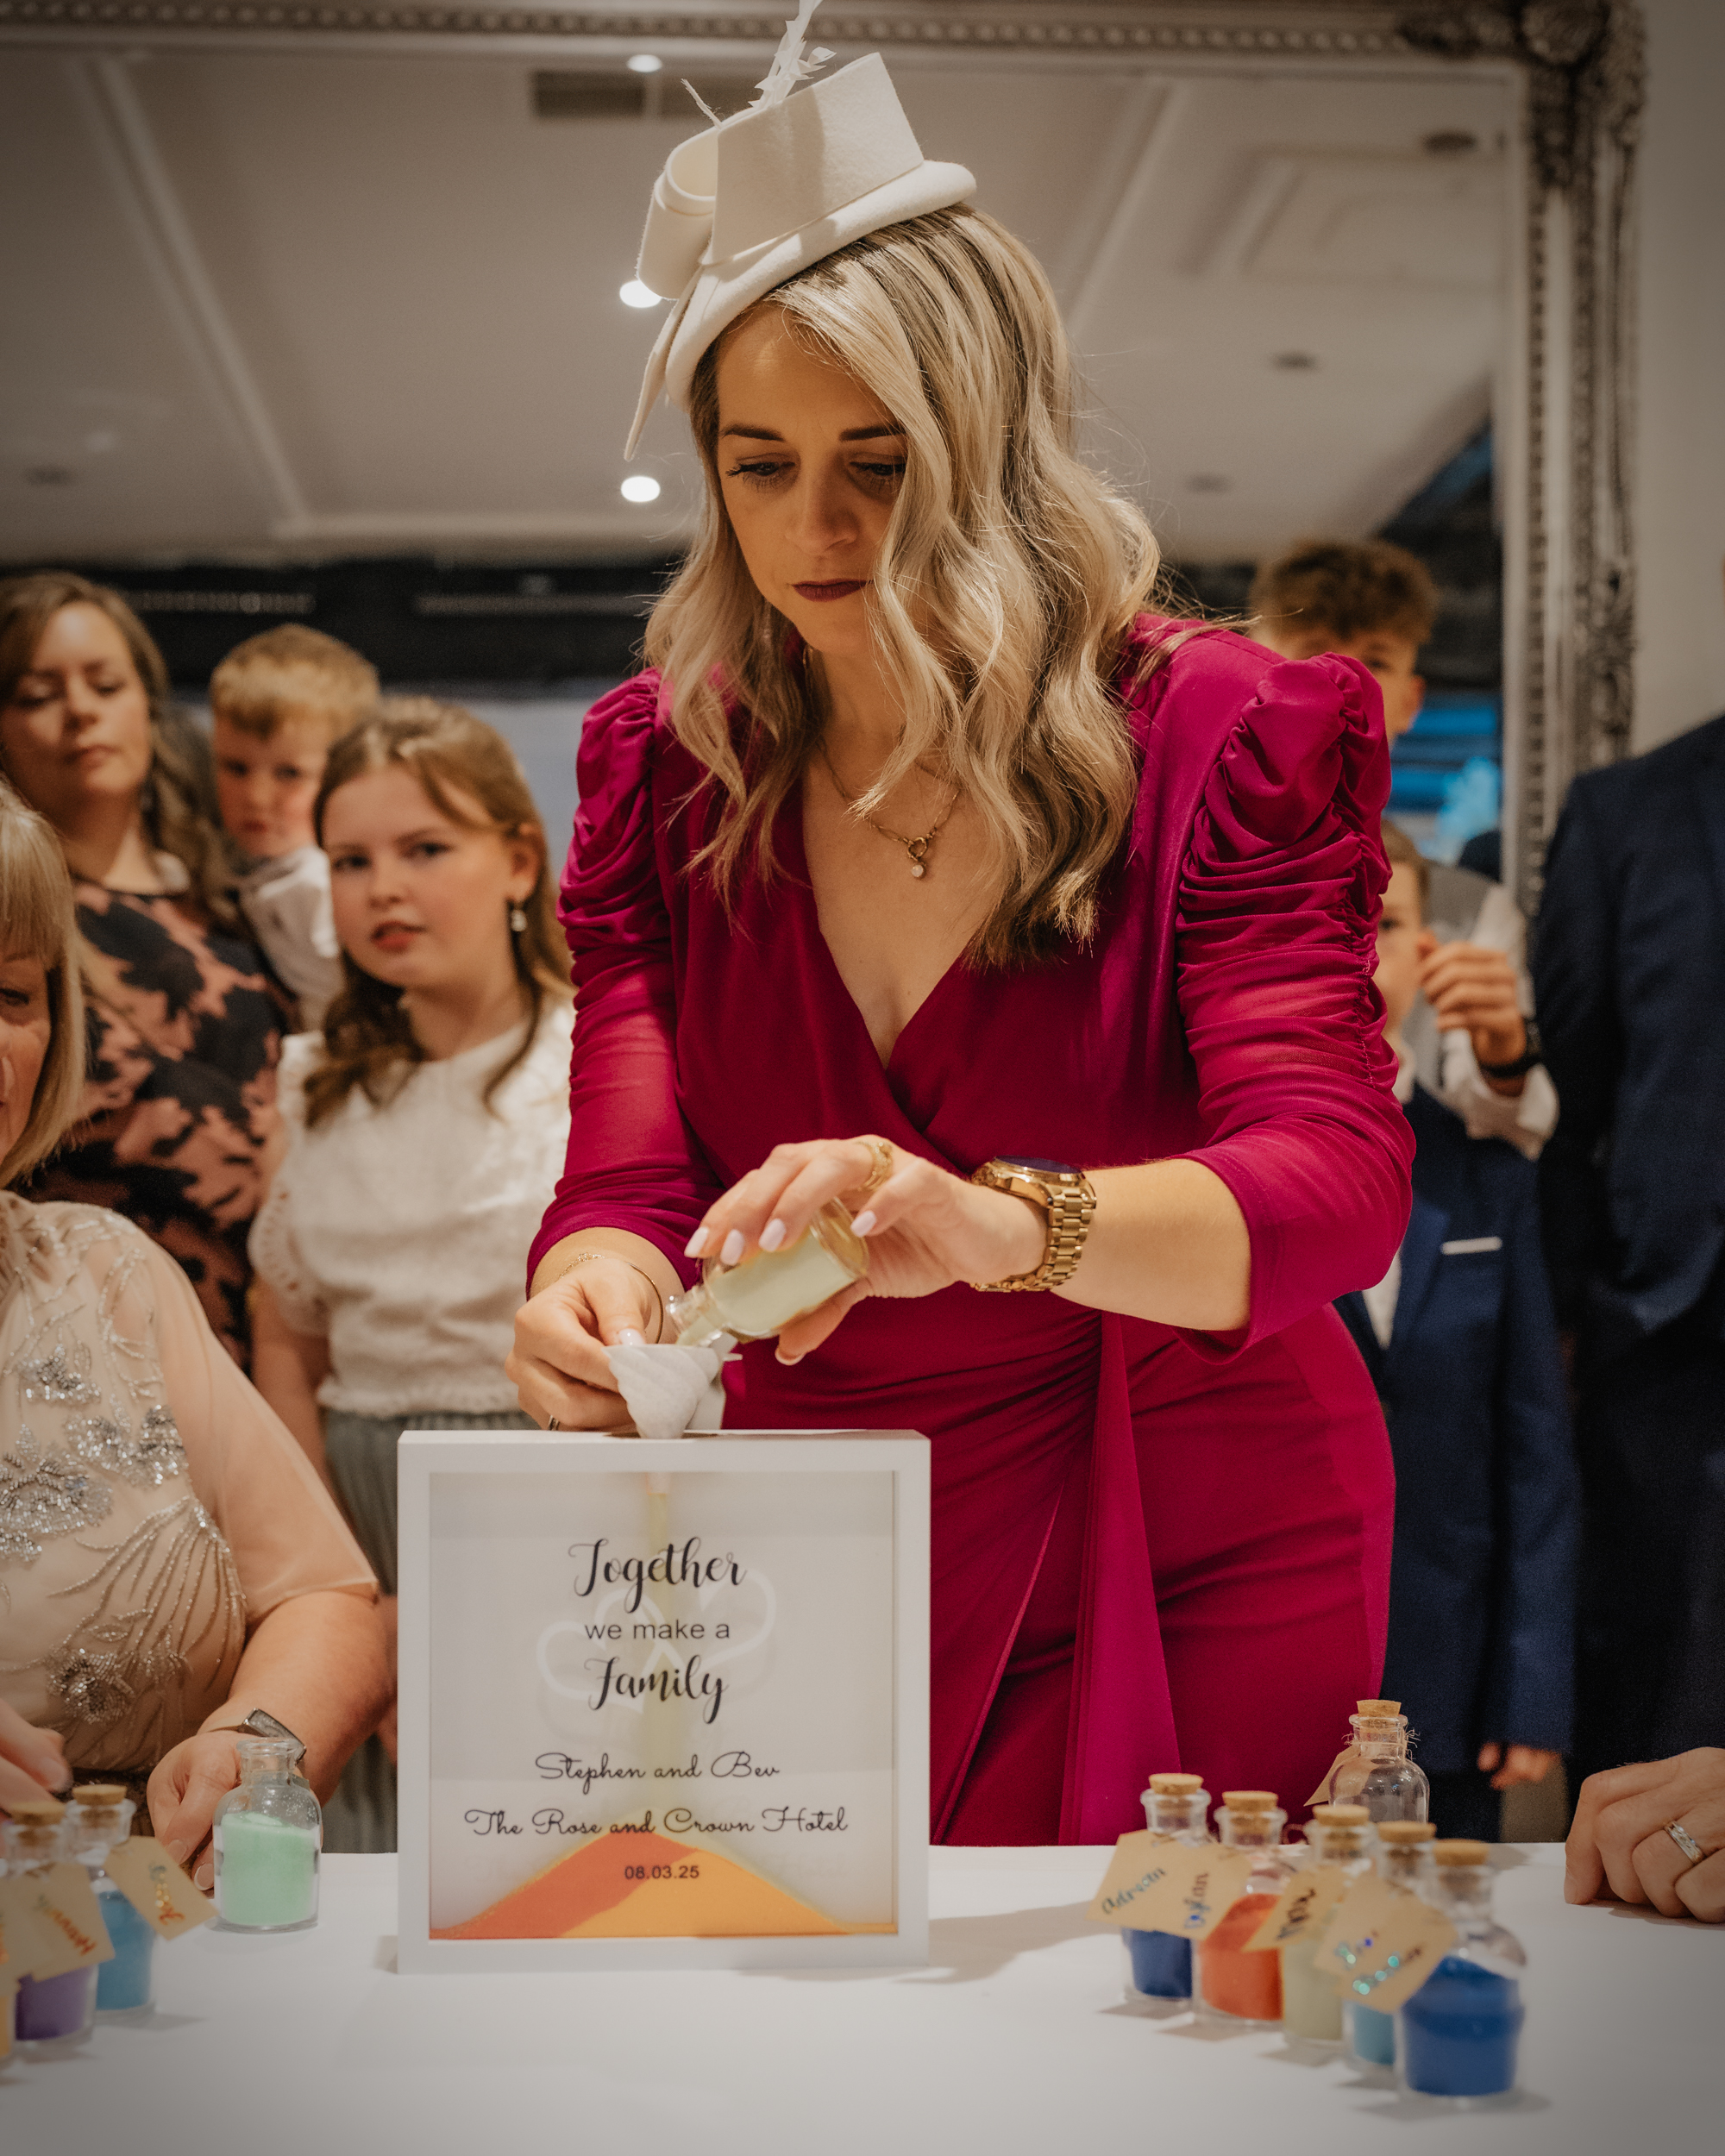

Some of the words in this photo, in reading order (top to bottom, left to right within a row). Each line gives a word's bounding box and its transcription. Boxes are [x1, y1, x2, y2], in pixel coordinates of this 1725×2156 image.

[568, 1536, 748, 1614] Together
[585, 1623, 622, 1639] we
[633, 1619, 705, 1639] make
[715, 1623, 730, 1639] a
[583, 1654, 730, 1725] Family
[535, 1752, 646, 1796] Stephen
[654, 1753, 702, 1778] and
[711, 1751, 780, 1778] Bev
[464, 1808, 523, 1836] The
[531, 1808, 602, 1835] Rose
[610, 1810, 656, 1834] and
[663, 1808, 755, 1833] Crown
[762, 1806, 848, 1833] Hotel
[624, 1865, 699, 1880] 08.03.25
